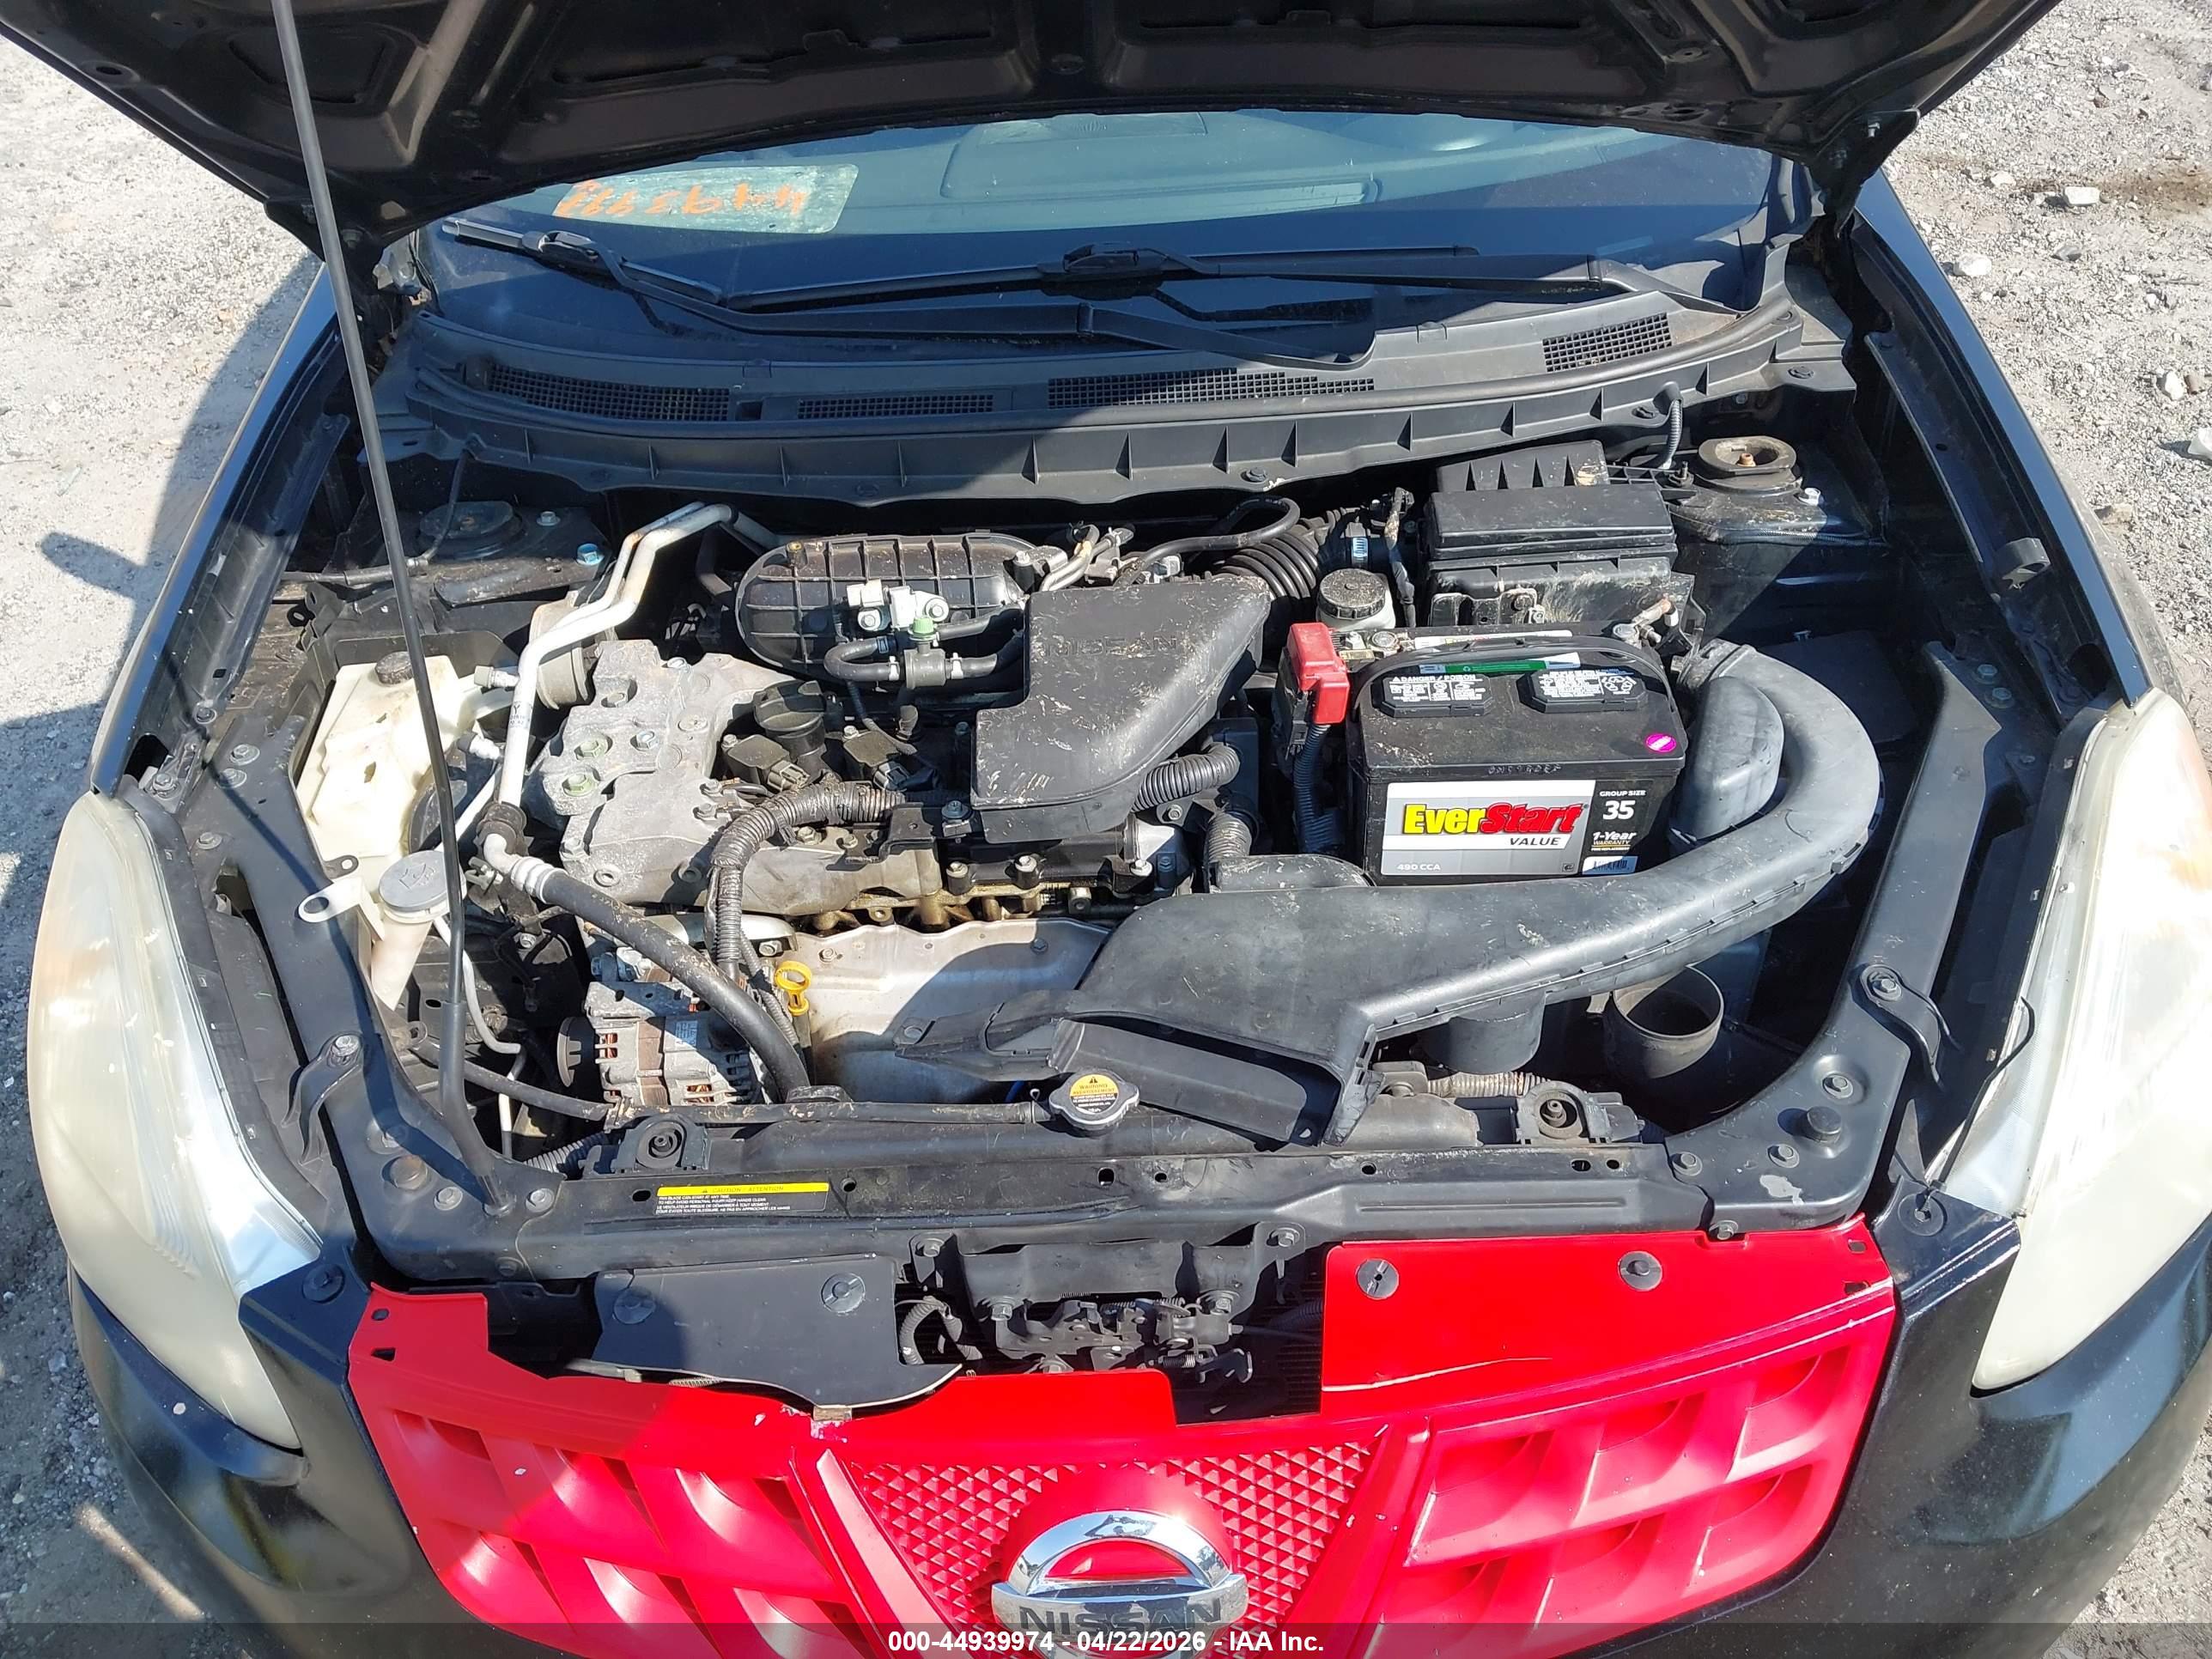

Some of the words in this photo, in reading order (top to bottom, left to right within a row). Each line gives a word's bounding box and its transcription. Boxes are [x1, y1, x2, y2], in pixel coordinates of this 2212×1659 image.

[1403, 802, 1584, 835] EverStart
[1602, 799, 1636, 820] 35
[1509, 836, 1561, 847] VALUE
[1592, 830, 1637, 841] 1-Year
[1018, 1597, 1221, 1636] NISSAN
